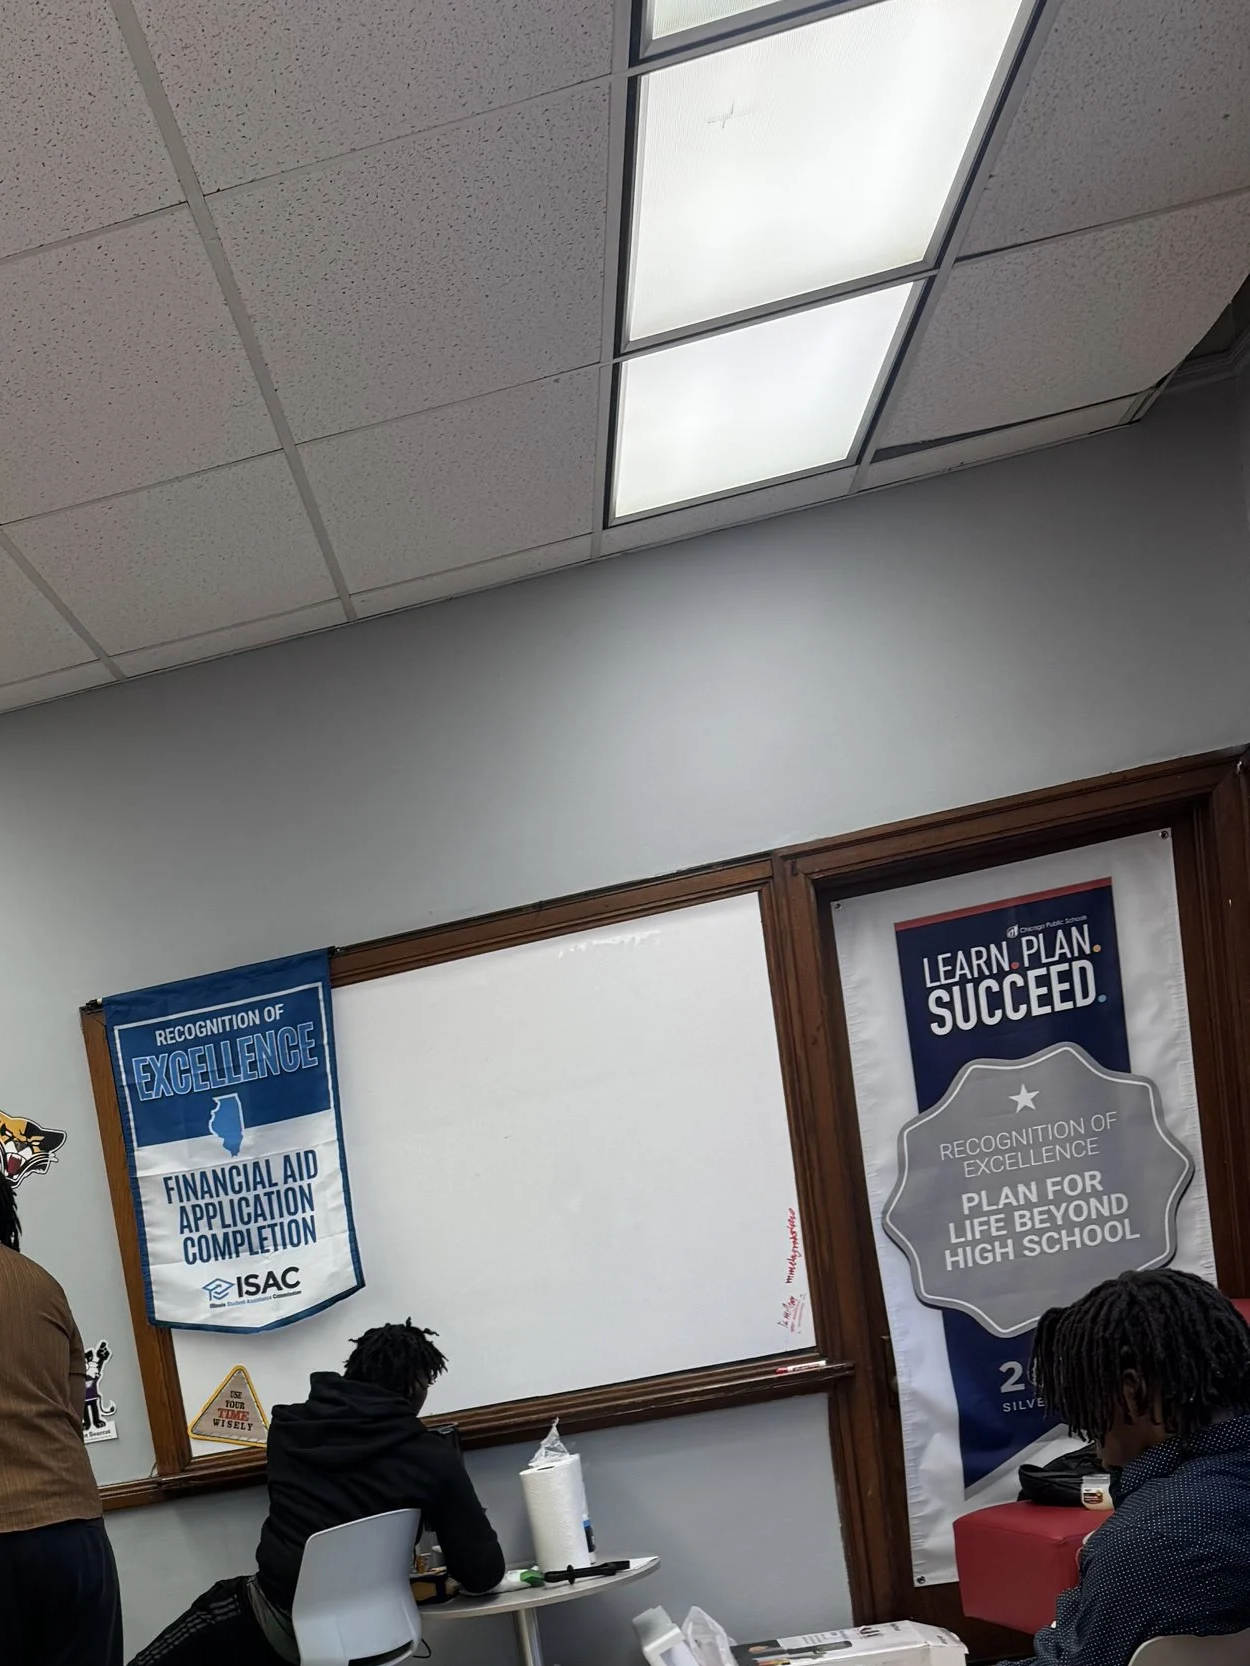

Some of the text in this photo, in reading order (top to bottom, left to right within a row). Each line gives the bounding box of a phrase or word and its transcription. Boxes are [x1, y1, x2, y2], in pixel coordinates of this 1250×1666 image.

[1019, 924, 1045, 934] Chicago
[1045, 919, 1064, 928] Public
[922, 924, 1102, 988] LEARN. PLAN.
[927, 959, 1107, 1036] SUCCEED.
[155, 1003, 285, 1046] RECOGNITION OF
[131, 1021, 319, 1101] EXCELLENCE
[940, 1111, 1117, 1161] RECOGNITION OF
[963, 1137, 1100, 1178] EXCELLENCE
[162, 1149, 318, 1204] FINANCIAL AID
[961, 1170, 1103, 1215] PLAN FOR
[179, 1183, 315, 1235] APPLICATION
[949, 1193, 1129, 1244] LIFE BEYOND
[183, 1215, 317, 1265] COMPLETION
[944, 1218, 1141, 1271] HIGH SCHOOL
[236, 1266, 301, 1298] ISAC
[217, 1408, 250, 1422] TIME
[225, 1400, 245, 1410] YOUR
[229, 1390, 243, 1399] USE
[1002, 1397, 1046, 1413] SILVE
[212, 1418, 253, 1431] WISELY
